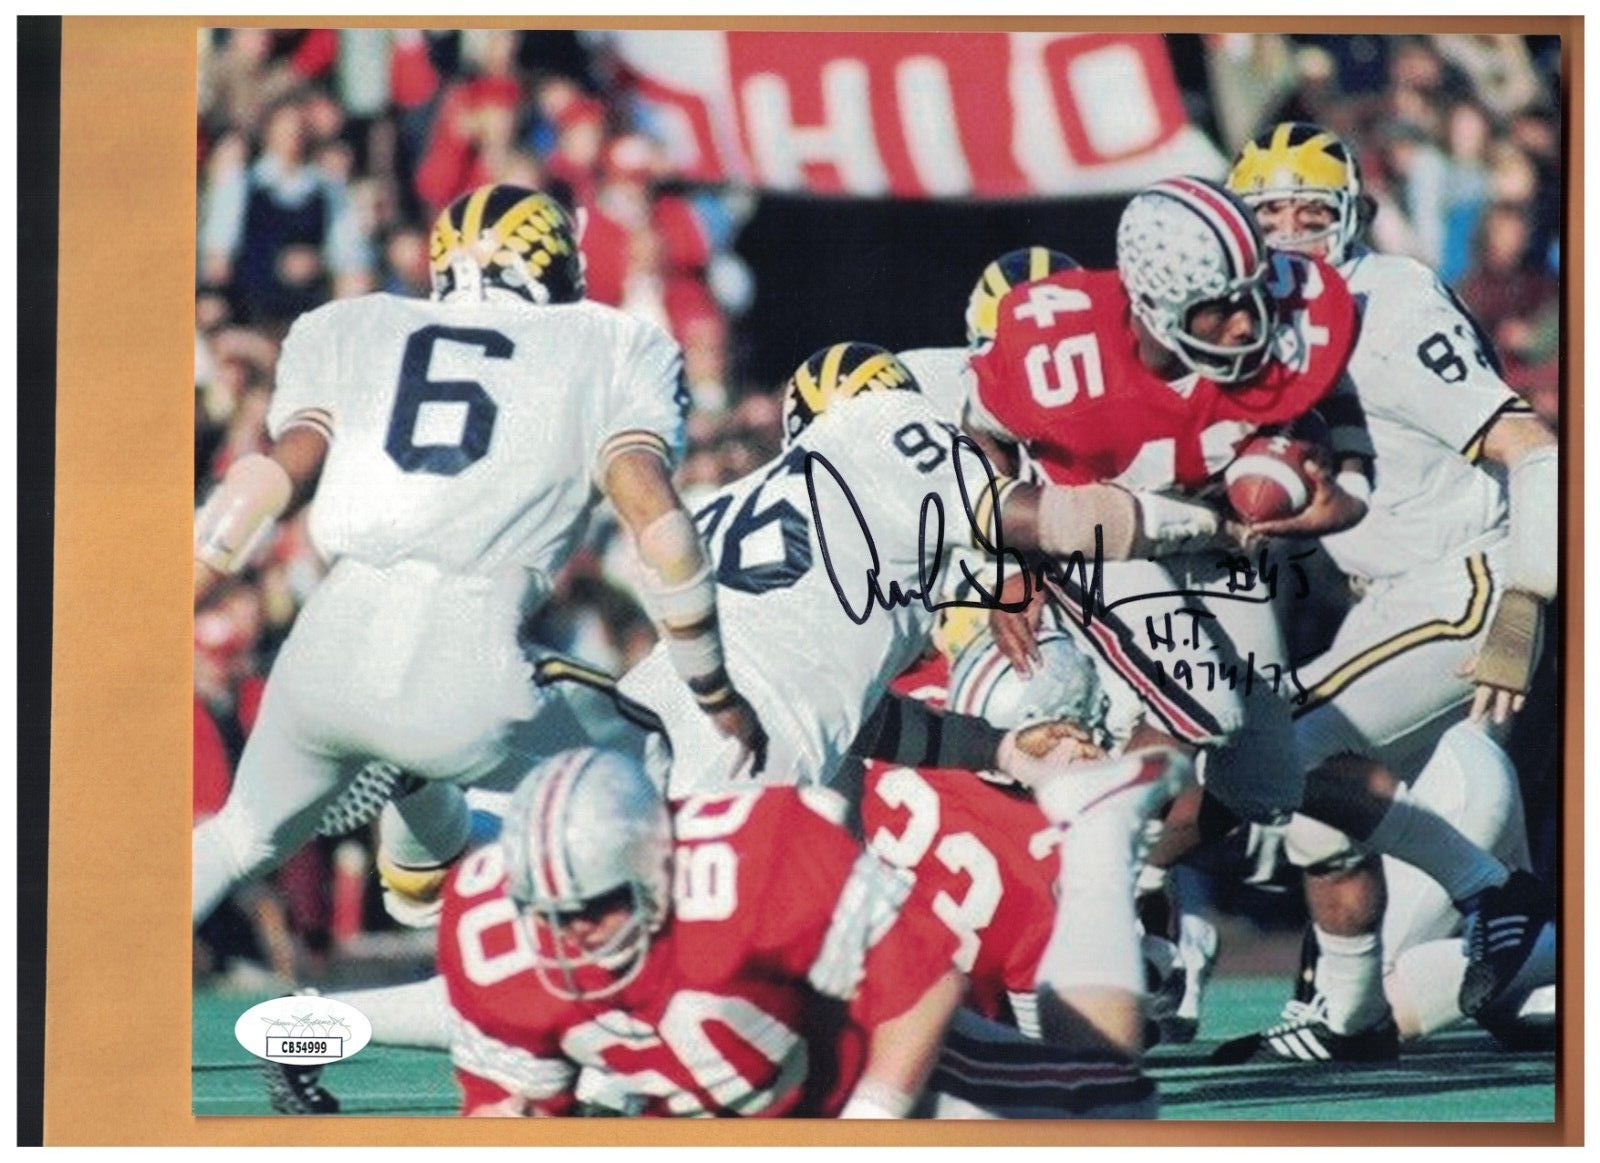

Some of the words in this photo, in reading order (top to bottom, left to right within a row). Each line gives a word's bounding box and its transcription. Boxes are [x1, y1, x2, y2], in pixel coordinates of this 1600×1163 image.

[384, 324, 516, 476] 6
[1013, 284, 1105, 408] 45
[281, 1041, 327, 1054] CB54999
